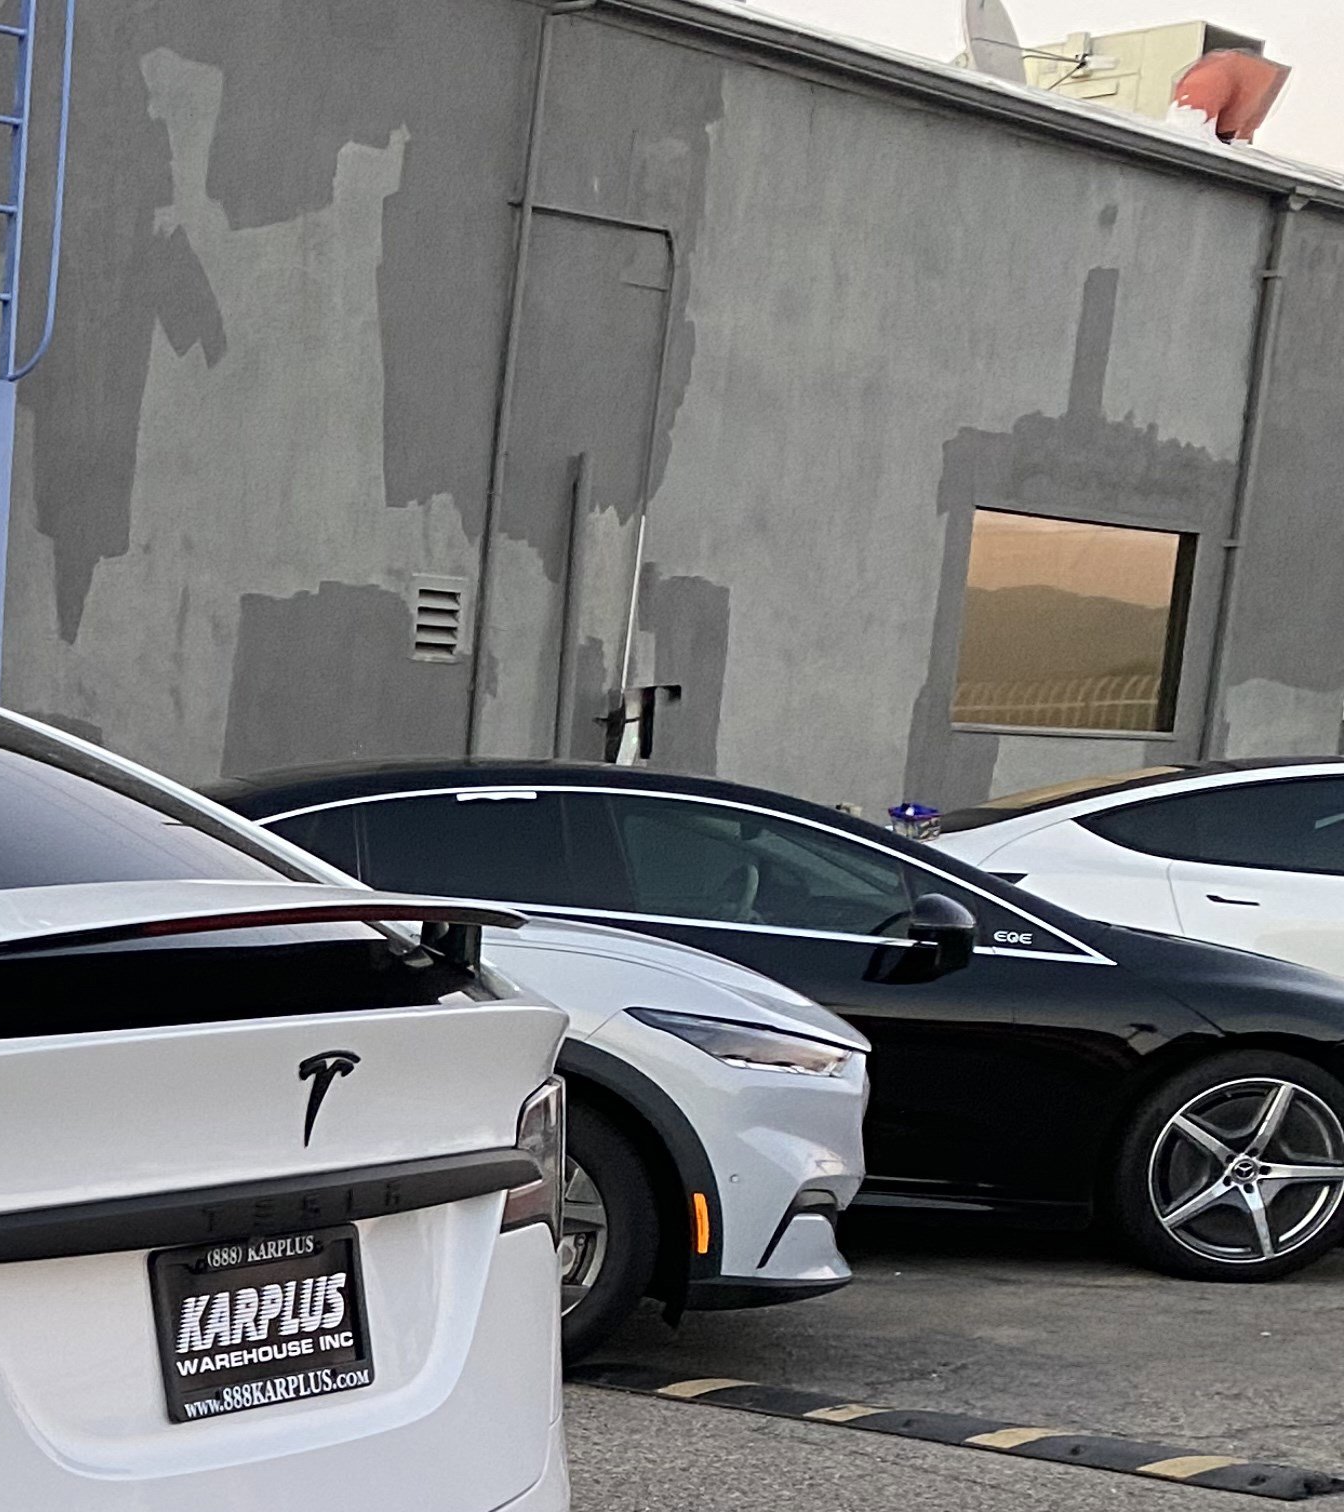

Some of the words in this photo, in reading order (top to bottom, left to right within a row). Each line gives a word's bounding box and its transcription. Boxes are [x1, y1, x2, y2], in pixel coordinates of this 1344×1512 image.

[993, 931, 1033, 944] EQE
[207, 1245, 243, 1267] (888)
[247, 1235, 314, 1262] KARPLUS
[176, 1272, 347, 1353] KARPLUS
[176, 1337, 314, 1377] WAREHOUSE
[318, 1331, 354, 1351] INC
